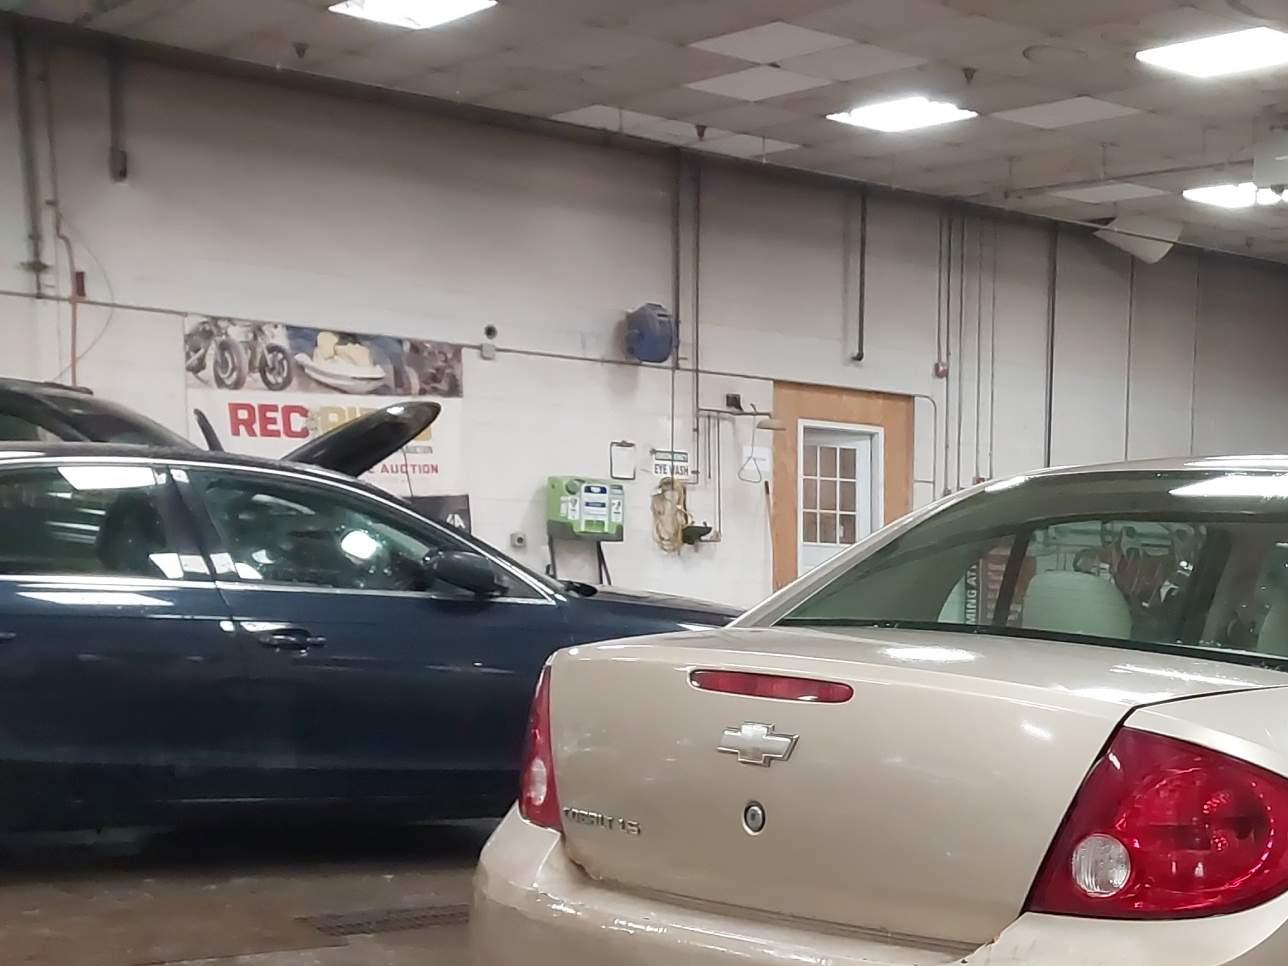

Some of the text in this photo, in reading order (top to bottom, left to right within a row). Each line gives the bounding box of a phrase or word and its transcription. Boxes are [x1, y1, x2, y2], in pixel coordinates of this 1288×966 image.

[228, 403, 310, 439] REC
[380, 463, 439, 474] AUCTION
[654, 463, 668, 475] EYE
